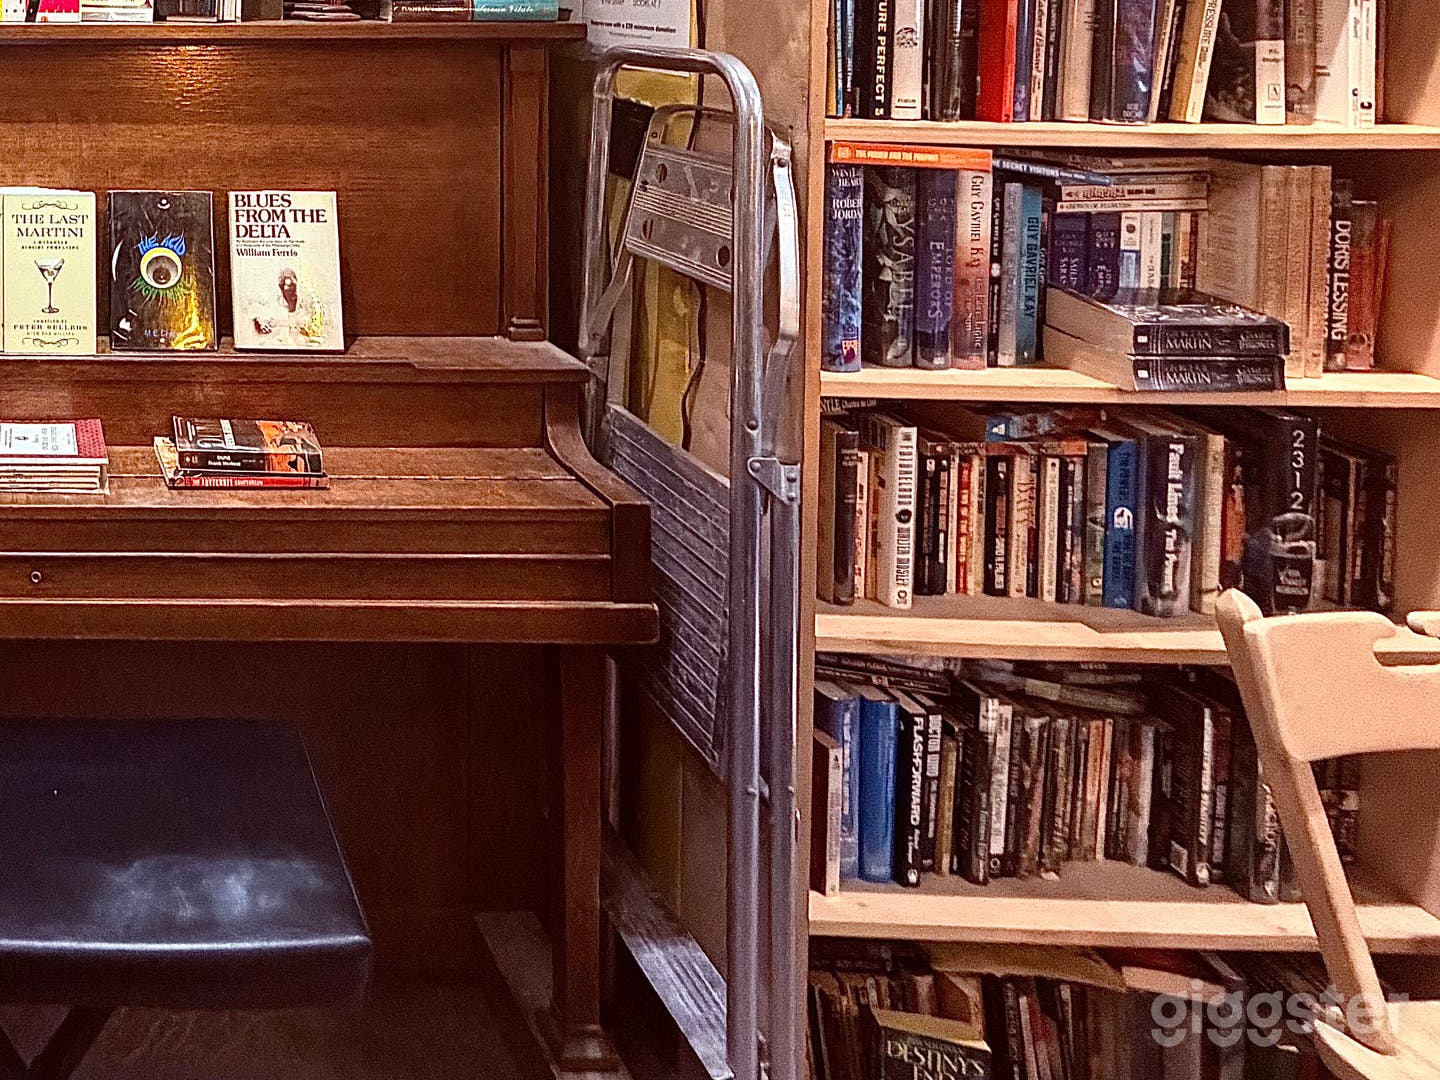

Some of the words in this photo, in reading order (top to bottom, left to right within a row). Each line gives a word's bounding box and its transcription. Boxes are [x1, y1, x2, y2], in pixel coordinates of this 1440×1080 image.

[876, 35, 885, 104] PERFECT
[235, 193, 292, 208] BLUES
[11, 214, 44, 225] THE
[49, 214, 89, 225] LAST
[235, 208, 291, 223] FROM
[293, 209, 328, 223] THE
[16, 227, 84, 238] MARTINI
[235, 224, 291, 239] DELTA
[1336, 220, 1351, 261] DORIS
[235, 248, 269, 258] William
[271, 249, 298, 258] Ferris
[1331, 264, 1349, 341] LESSING
[1166, 337, 1211, 352] MARTIN
[1165, 371, 1211, 387] MARTIN
[1291, 428, 1305, 510] 2312
